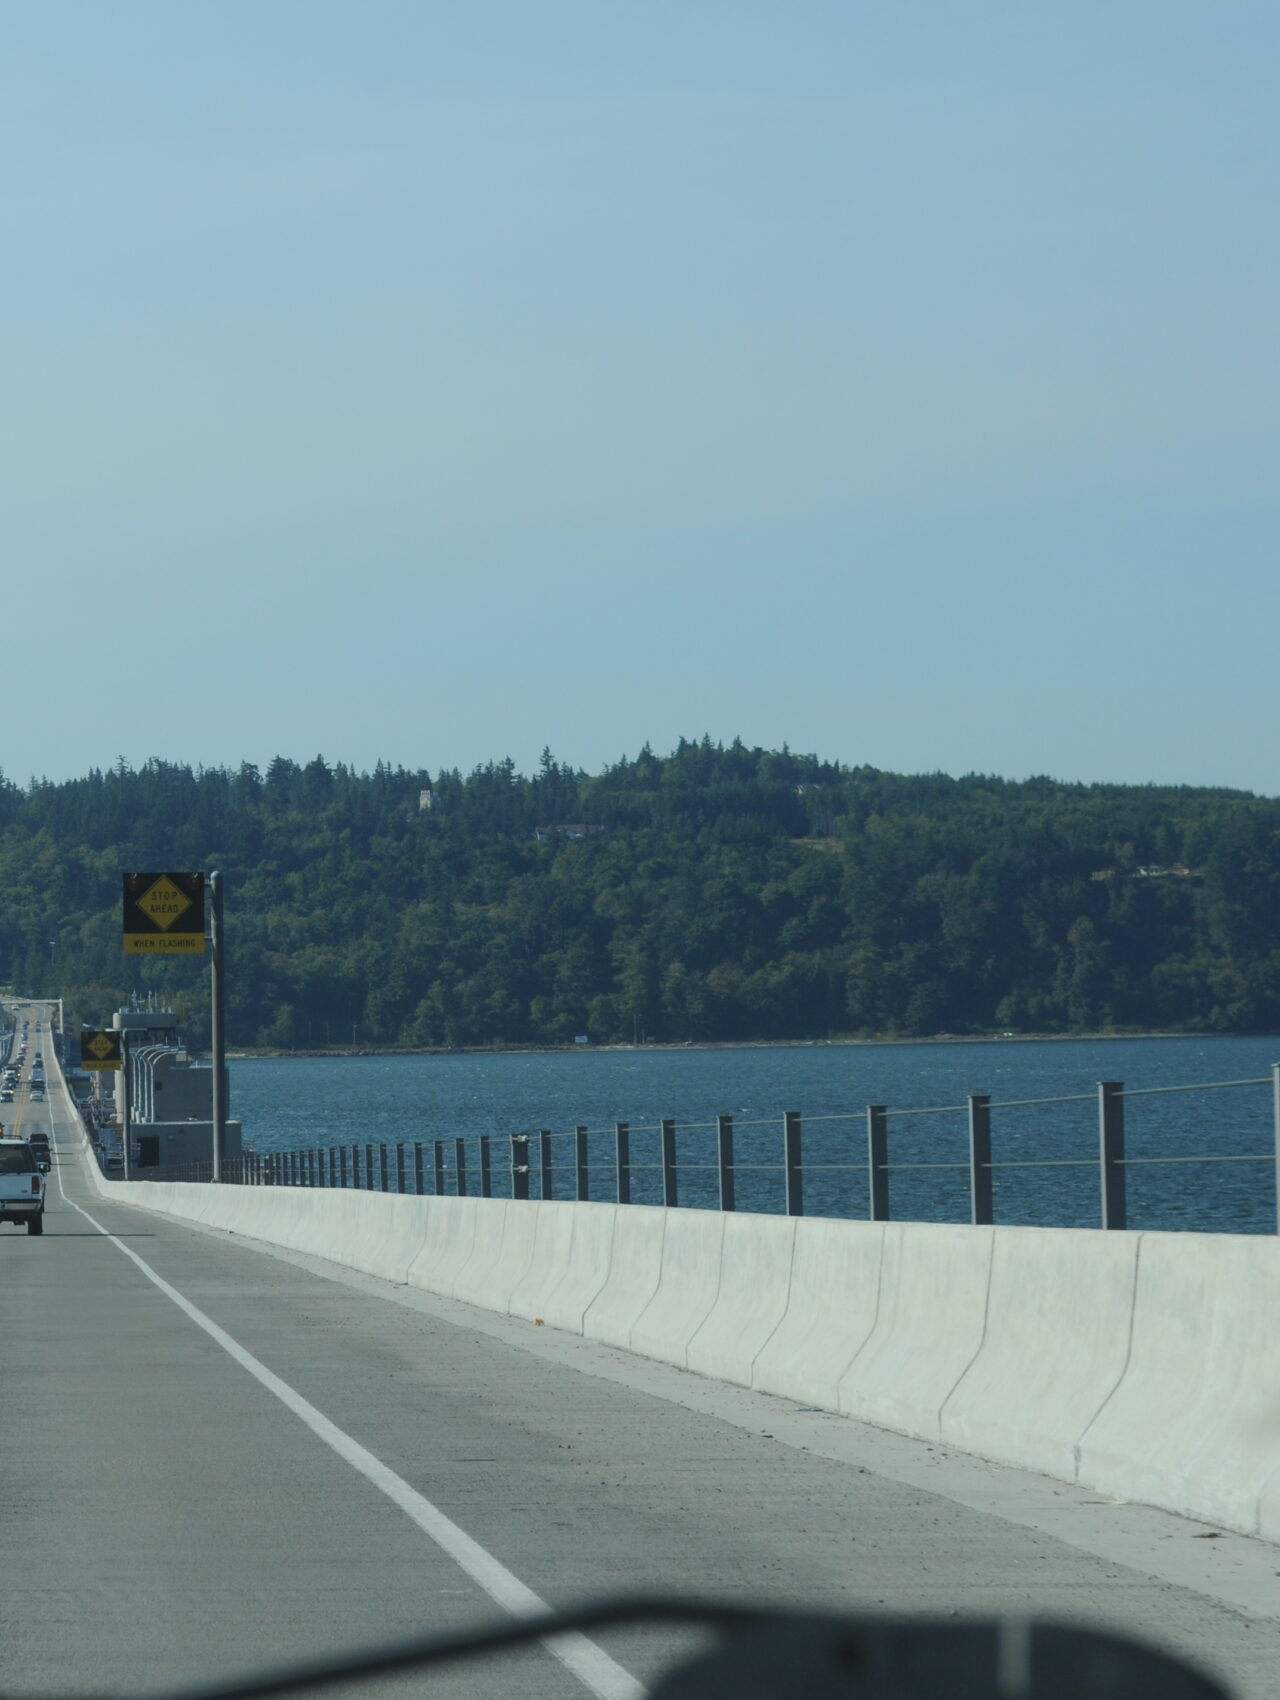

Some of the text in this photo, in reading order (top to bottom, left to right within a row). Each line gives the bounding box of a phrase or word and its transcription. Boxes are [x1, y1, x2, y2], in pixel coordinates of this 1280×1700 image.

[151, 891, 177, 900] STOP
[150, 904, 178, 913] AHEAD
[133, 939, 196, 948] WHEN FLASHING
